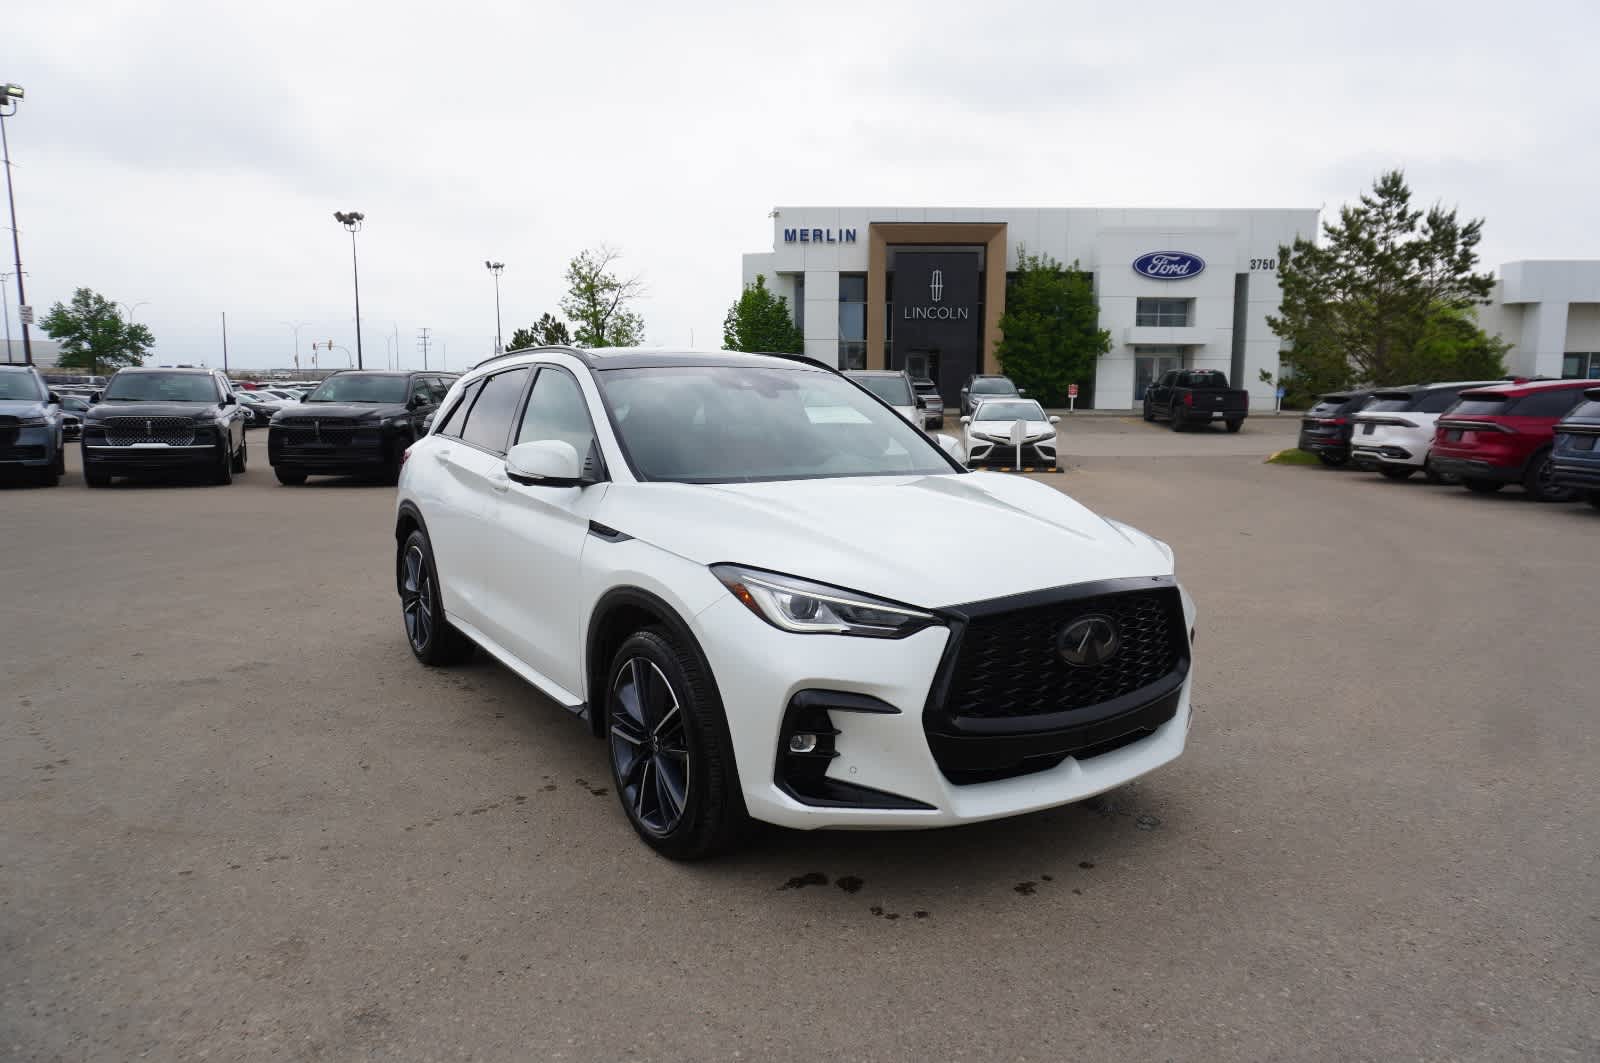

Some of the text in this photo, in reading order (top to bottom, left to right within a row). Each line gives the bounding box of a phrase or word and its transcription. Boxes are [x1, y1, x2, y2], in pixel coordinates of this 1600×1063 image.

[784, 228, 856, 242] MERLIN
[1147, 254, 1191, 274] Ford
[1250, 258, 1275, 270] 3750
[904, 306, 968, 319] LINCOLN
